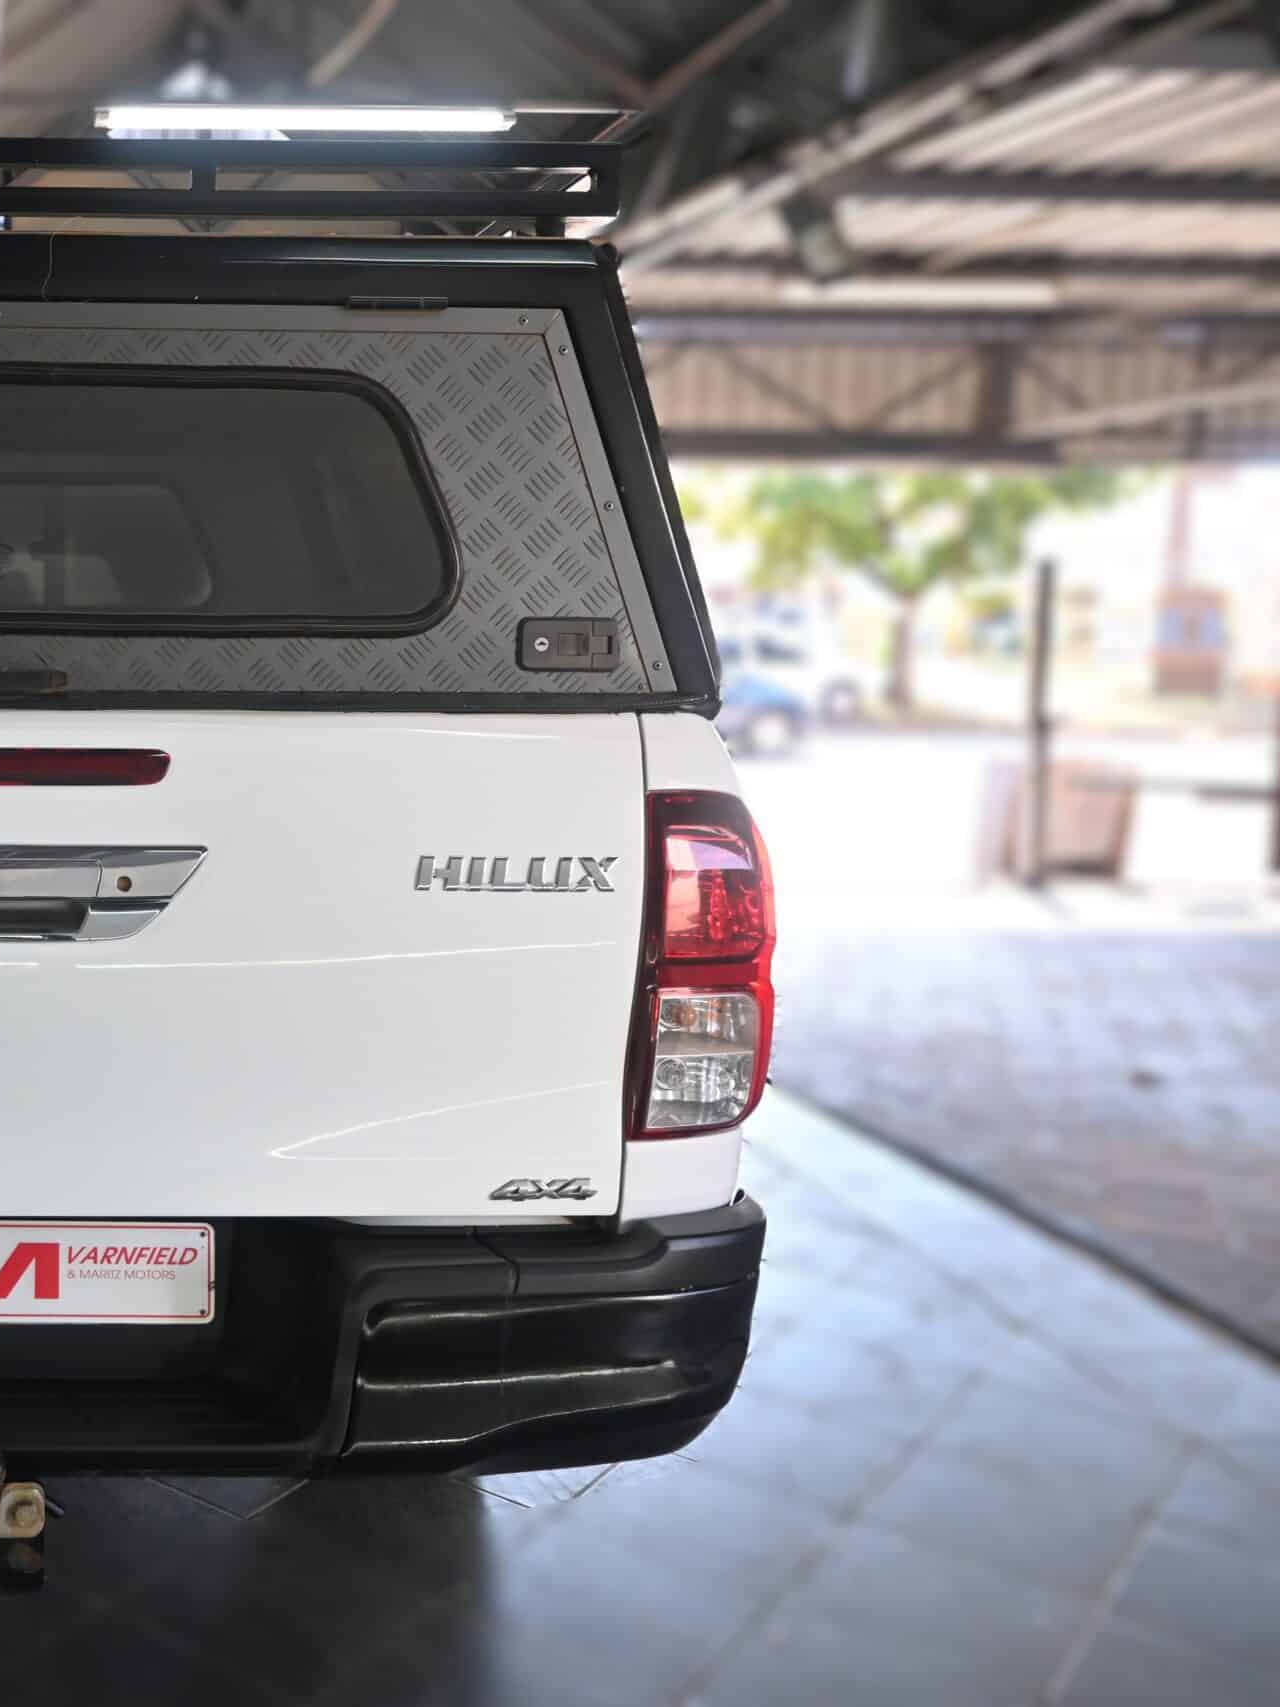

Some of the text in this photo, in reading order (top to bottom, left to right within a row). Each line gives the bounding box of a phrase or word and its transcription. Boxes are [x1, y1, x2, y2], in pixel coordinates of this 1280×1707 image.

[414, 855, 619, 892] HILUX
[67, 1246, 199, 1265] VARNFIELD
[66, 1269, 177, 1281] & MARITZ MOTORS
